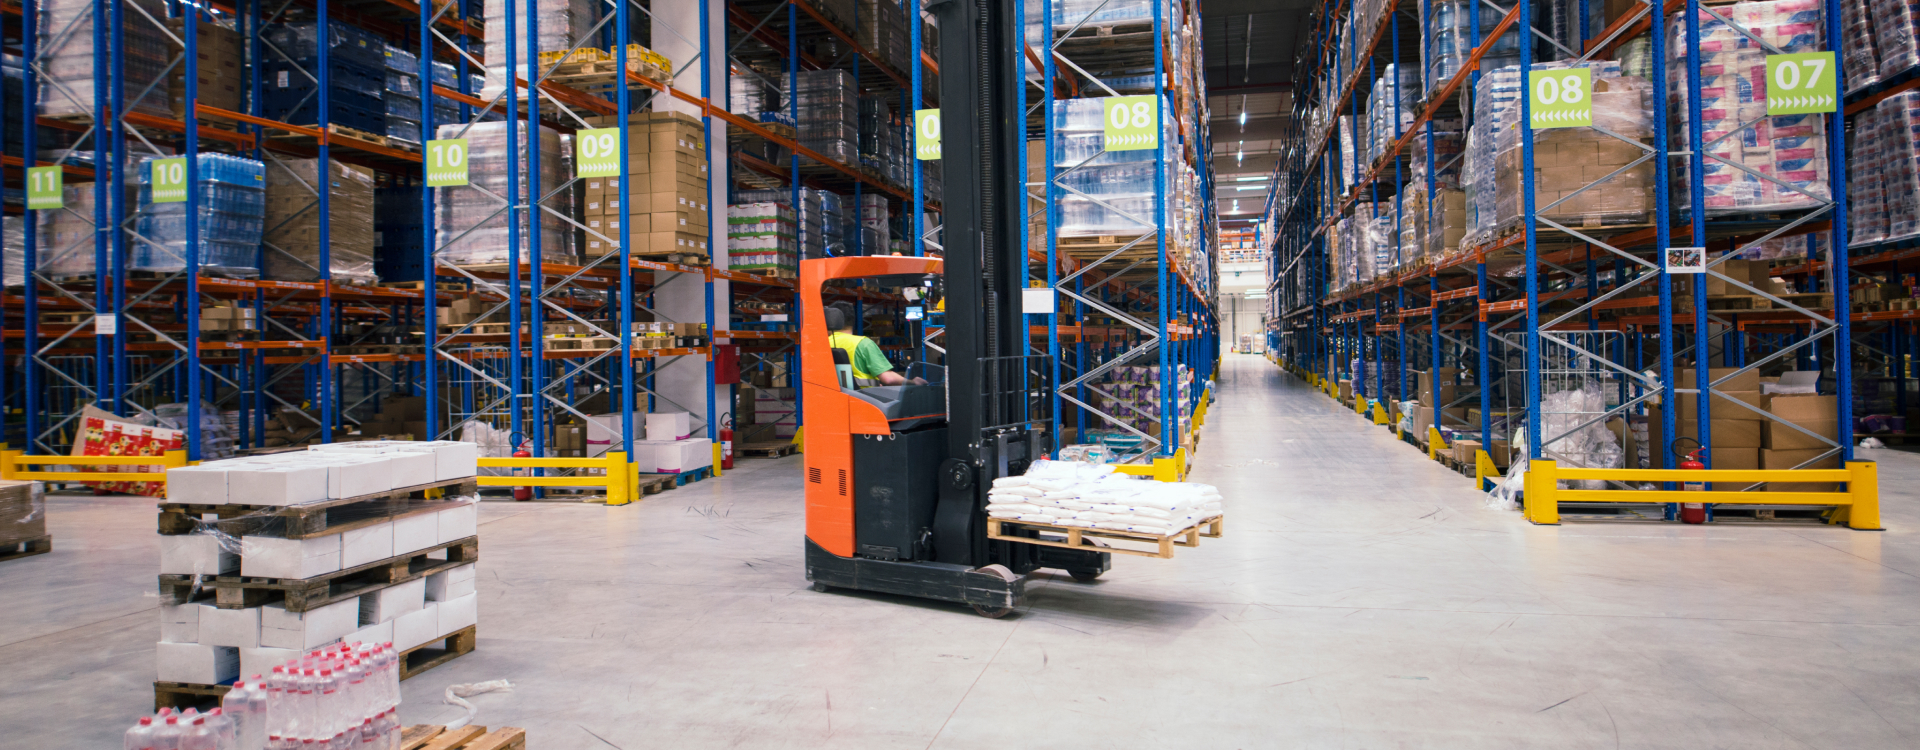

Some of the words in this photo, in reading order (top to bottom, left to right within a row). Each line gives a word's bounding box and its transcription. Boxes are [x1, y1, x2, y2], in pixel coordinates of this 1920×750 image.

[1775, 59, 1827, 90] 07
[1536, 75, 1584, 104] 08
[921, 114, 941, 139] 0
[1111, 102, 1152, 129] 08
[433, 144, 463, 167] 10
[582, 134, 615, 158] 09
[32, 171, 56, 192] 11
[158, 162, 183, 184] 10
